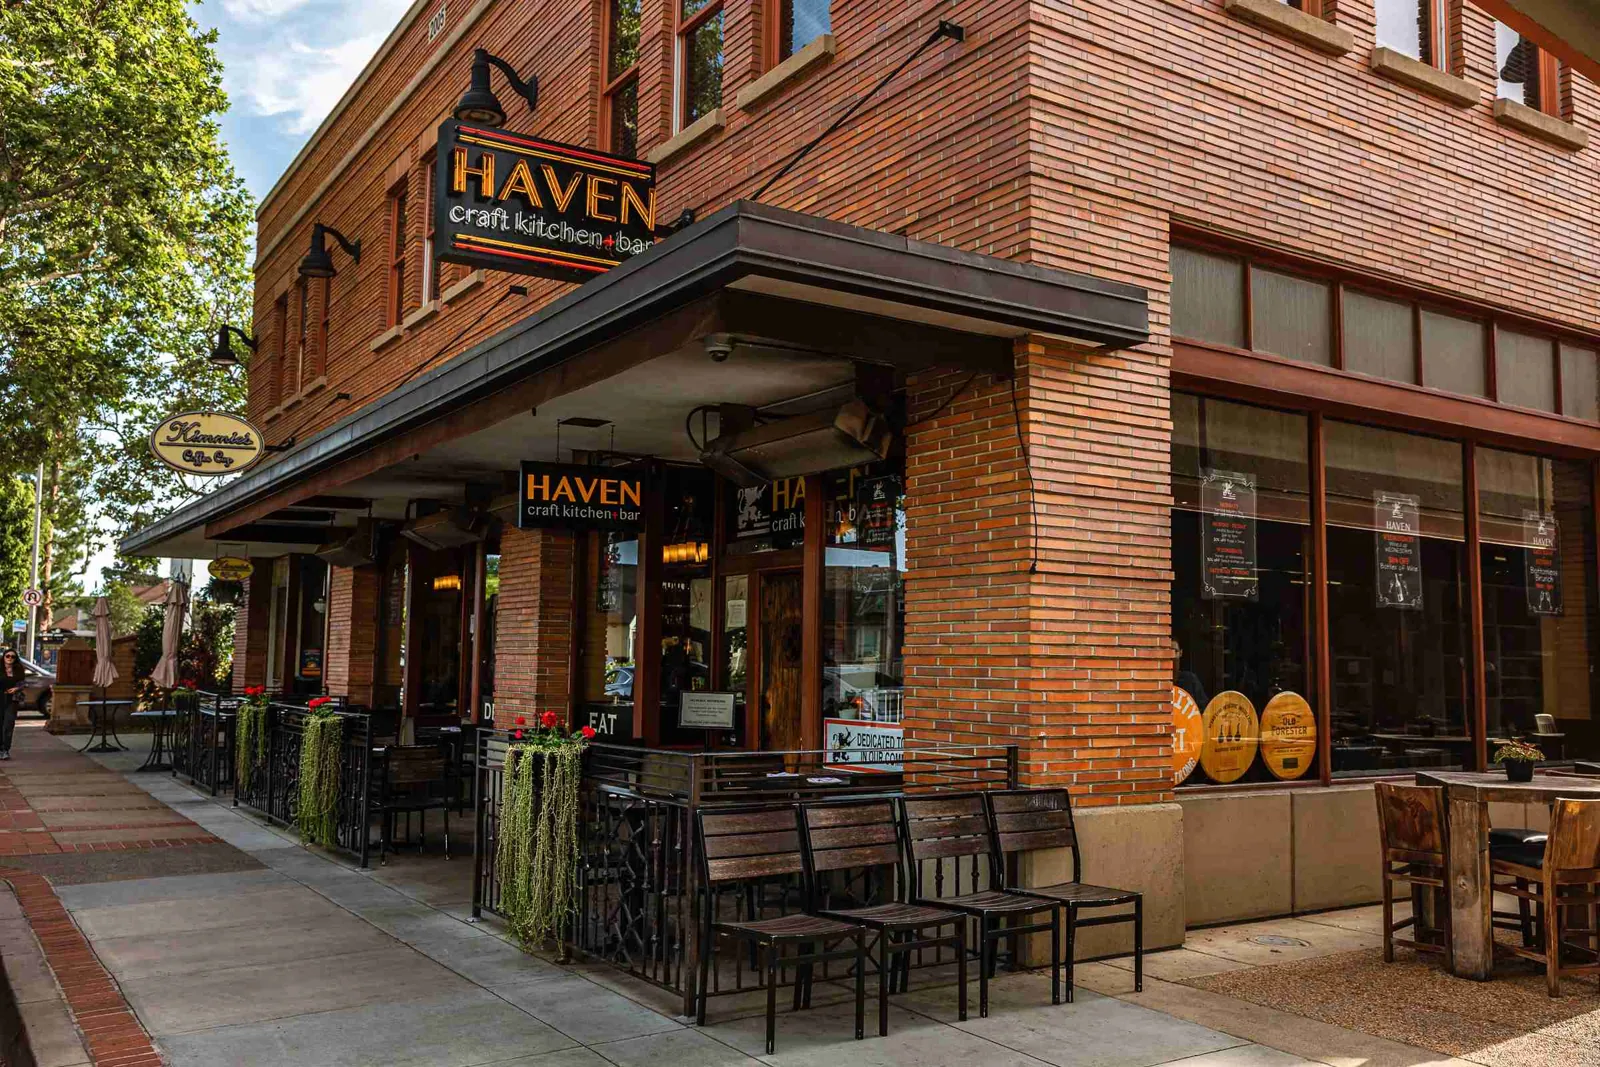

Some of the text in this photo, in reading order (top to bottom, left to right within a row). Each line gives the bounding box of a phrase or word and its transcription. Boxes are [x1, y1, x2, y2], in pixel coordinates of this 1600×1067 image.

[453, 144, 657, 232] HAVEN
[449, 205, 510, 232] craft
[213, 450, 235, 468] Cup
[527, 473, 641, 507] HAVEN
[527, 503, 560, 517] craft
[771, 512, 797, 533] craft
[1386, 520, 1411, 532] HAVEN
[589, 712, 618, 735] EAT
[1282, 717, 1297, 726] OLD
[1271, 725, 1308, 737] FORESTER
[857, 733, 895, 749] DEDICATED
